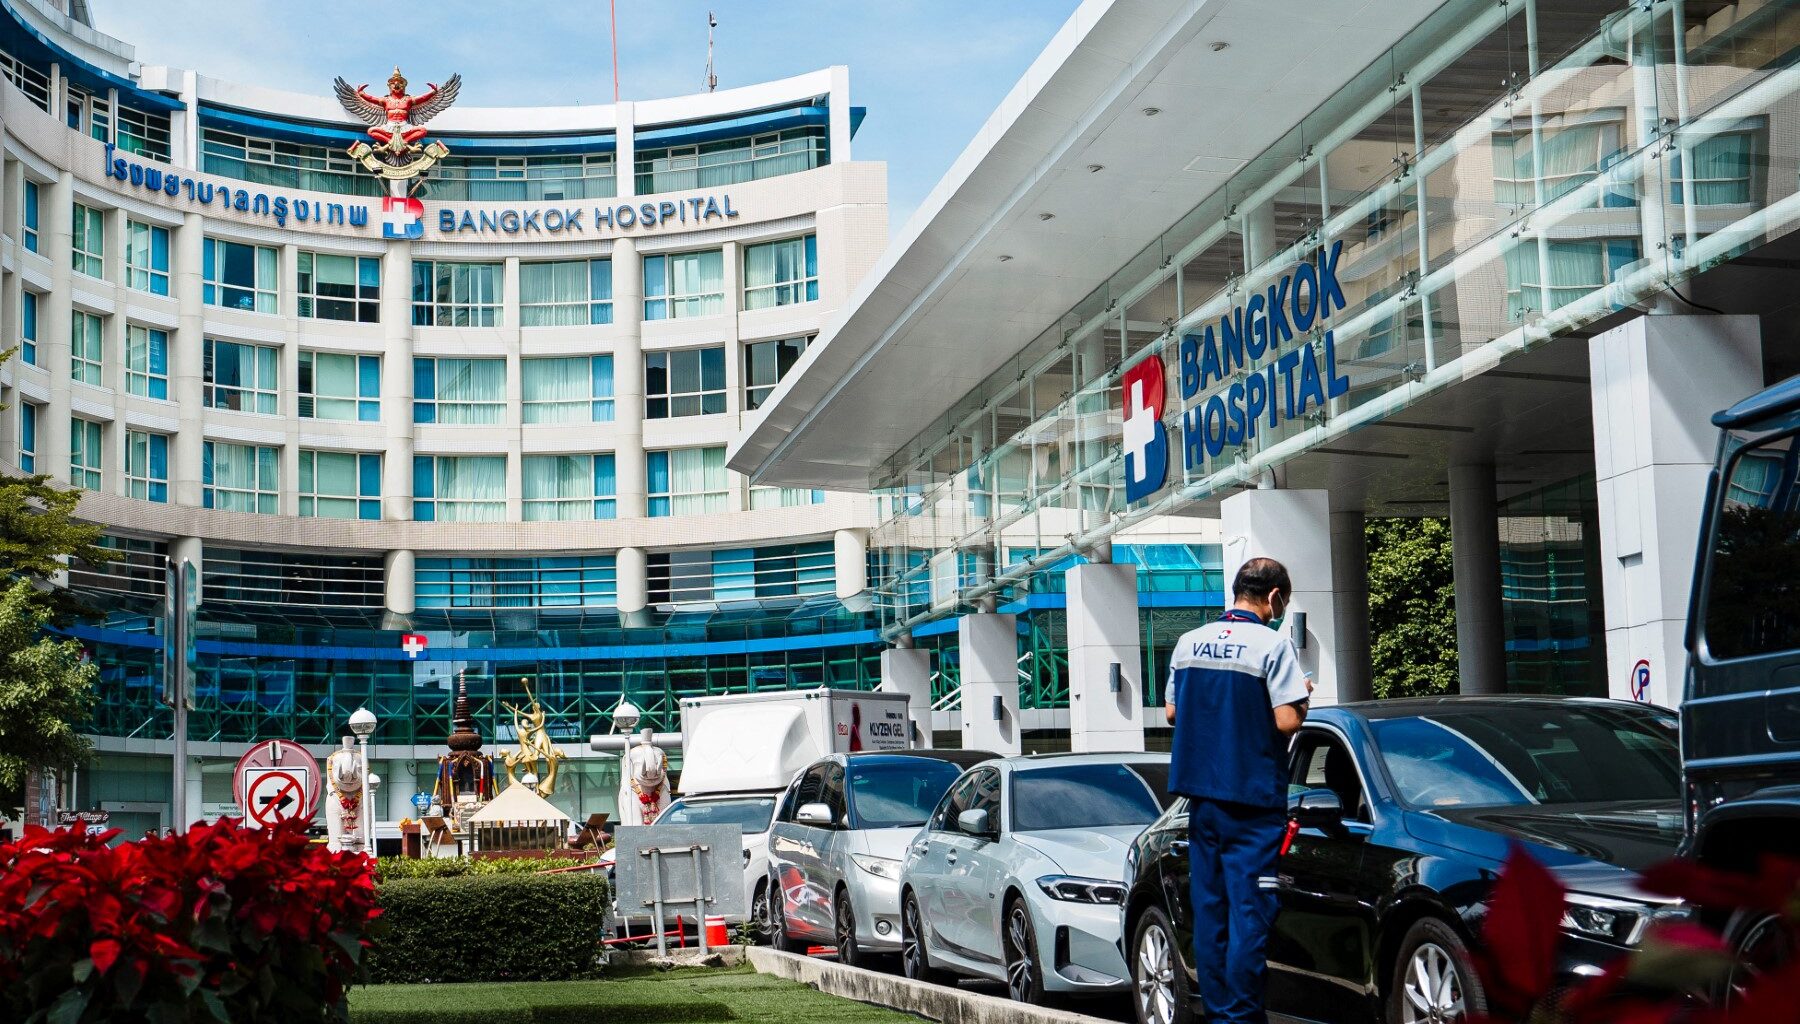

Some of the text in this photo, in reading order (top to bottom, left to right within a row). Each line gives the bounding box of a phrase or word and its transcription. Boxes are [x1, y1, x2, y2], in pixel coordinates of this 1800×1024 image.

[104, 142, 368, 228] โรงพยาบาลกรุงเทพ
[438, 194, 739, 233] BANGKOK HOSPITAL
[1180, 240, 1346, 401] BANGKOK
[1183, 330, 1349, 471] HOSPITAL
[1193, 642, 1247, 659] VALET
[869, 722, 905, 738] KLYZEN GEL
